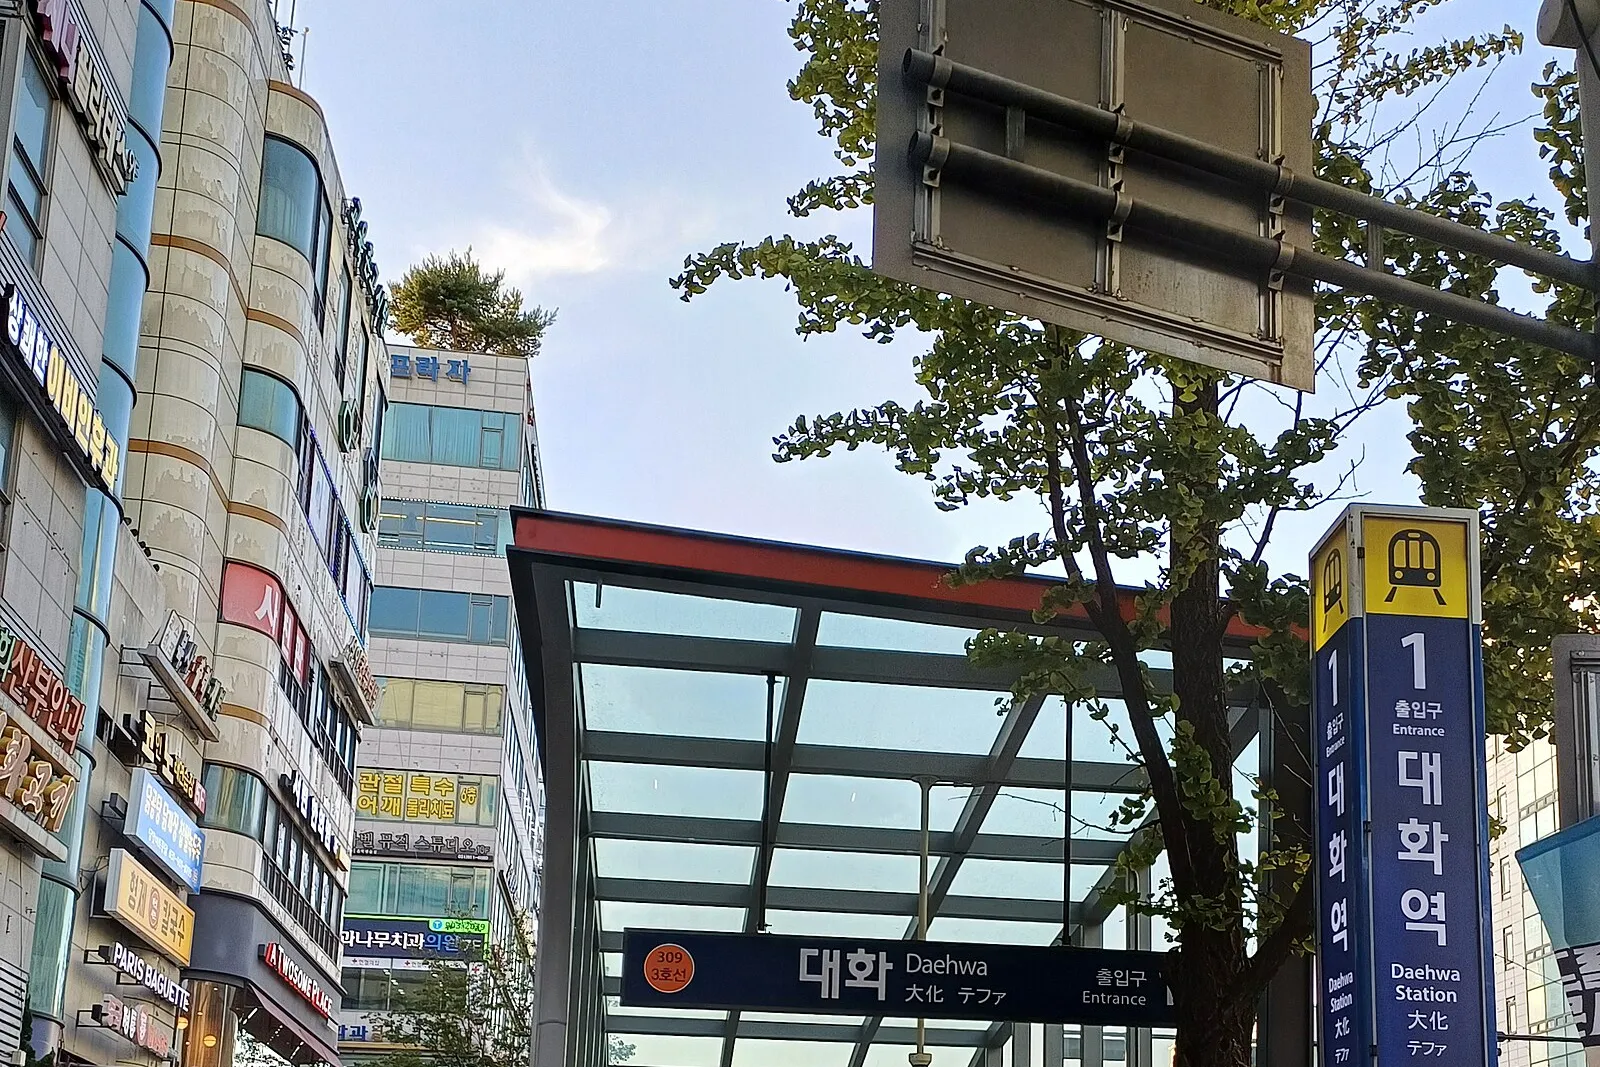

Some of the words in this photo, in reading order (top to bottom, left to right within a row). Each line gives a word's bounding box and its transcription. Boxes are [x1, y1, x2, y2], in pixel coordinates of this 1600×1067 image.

[47, 345, 120, 493] 이비인후과
[1401, 632, 1427, 690] 1
[1328, 649, 1338, 707] 1
[1394, 699, 1443, 721] 출입구
[1392, 723, 1446, 738] Entrance
[358, 771, 404, 794] 관절
[410, 775, 454, 796] 특수
[460, 786, 477, 804] 6층
[357, 795, 402, 815] 어깨
[406, 797, 455, 819] 물리치료
[378, 832, 409, 851] 뮤직
[413, 834, 476, 853] 스튜디오
[657, 951, 683, 963] 309
[906, 953, 988, 976] Daehwa
[113, 942, 146, 982] PARIS
[145, 964, 191, 1013] BAGUETTE
[651, 967, 686, 983] 3호선
[799, 948, 894, 1001] 대화
[1096, 968, 1147, 988] 출입구
[1328, 971, 1354, 994] Daehwa
[1391, 963, 1461, 983] Daehwa
[310, 978, 334, 1017] PLACE
[905, 984, 944, 1003] 大化
[957, 986, 1007, 1005] テファ
[1082, 990, 1147, 1006] Entrance
[1330, 992, 1353, 1013] Station
[1395, 985, 1458, 1004] Station
[1334, 1016, 1350, 1039] 大化
[1406, 1009, 1449, 1031] 大化
[1406, 1039, 1448, 1057] テファ
